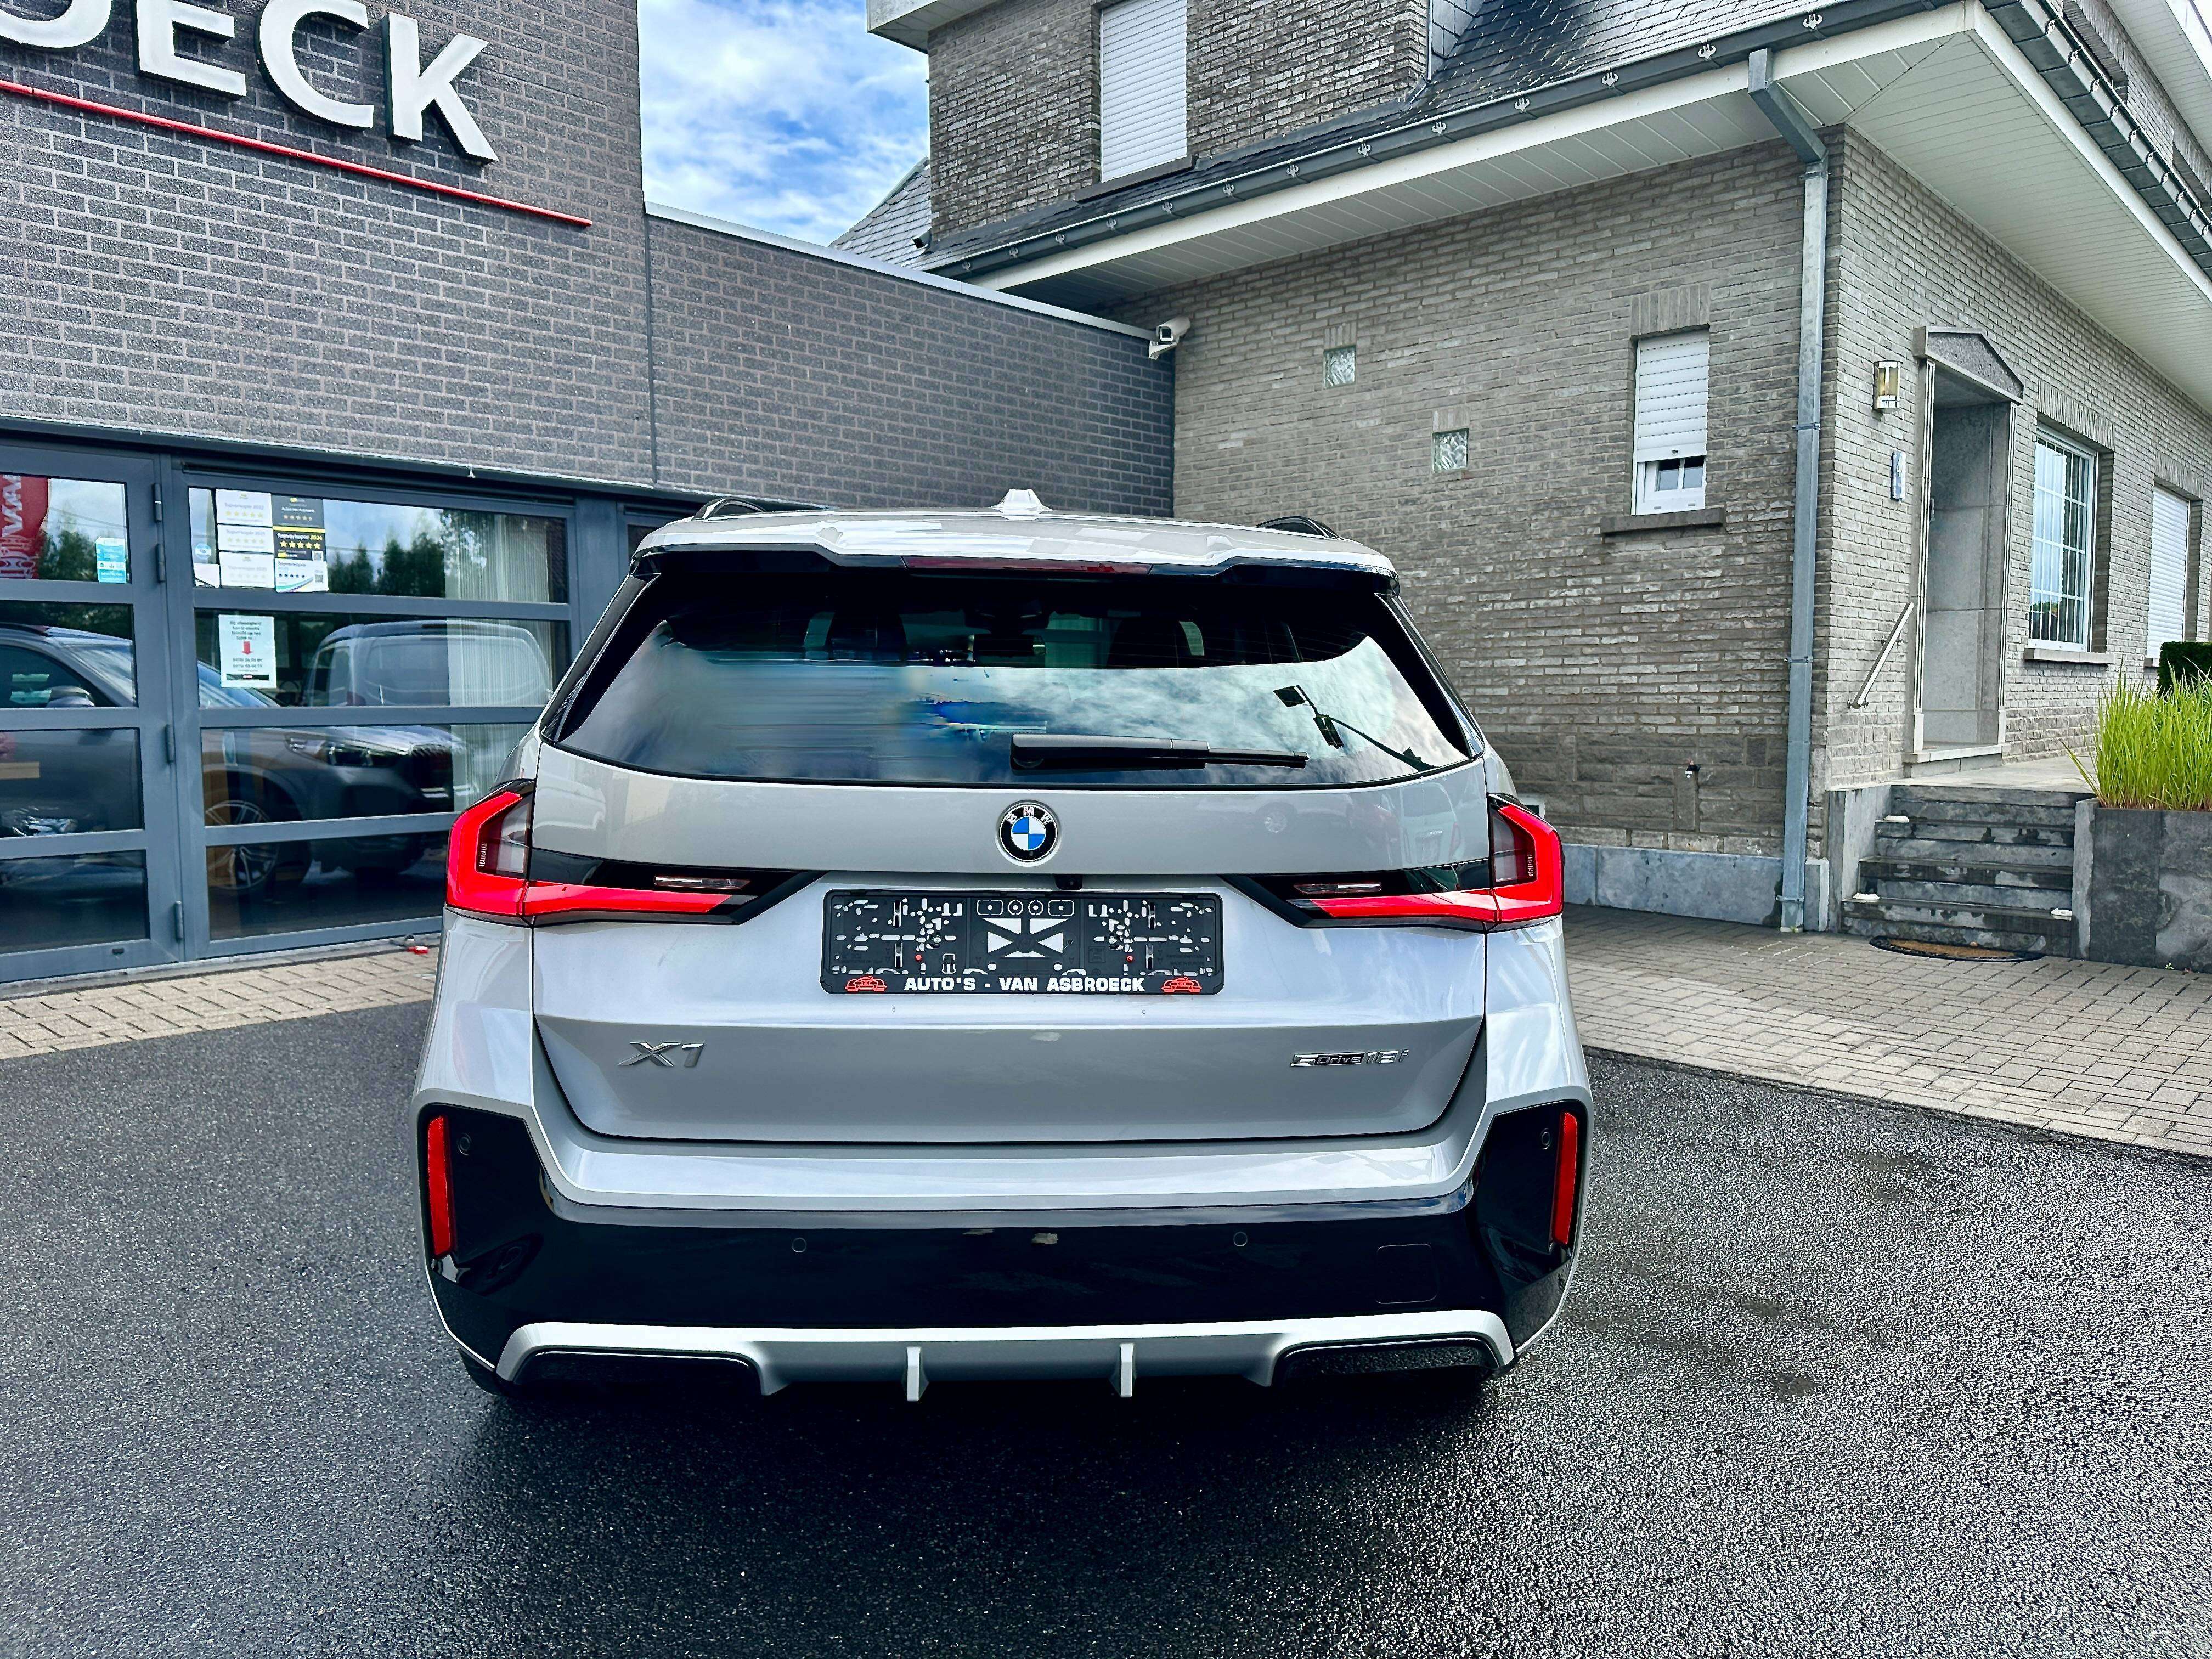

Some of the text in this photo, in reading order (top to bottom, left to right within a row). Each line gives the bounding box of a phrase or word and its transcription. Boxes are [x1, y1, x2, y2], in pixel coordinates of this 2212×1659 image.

[1006, 806, 1053, 825] BMW
[904, 977, 976, 991] AUTO'S
[998, 977, 1038, 991] VAN
[1046, 977, 1146, 992] ASBROECK
[617, 1041, 704, 1068] X1
